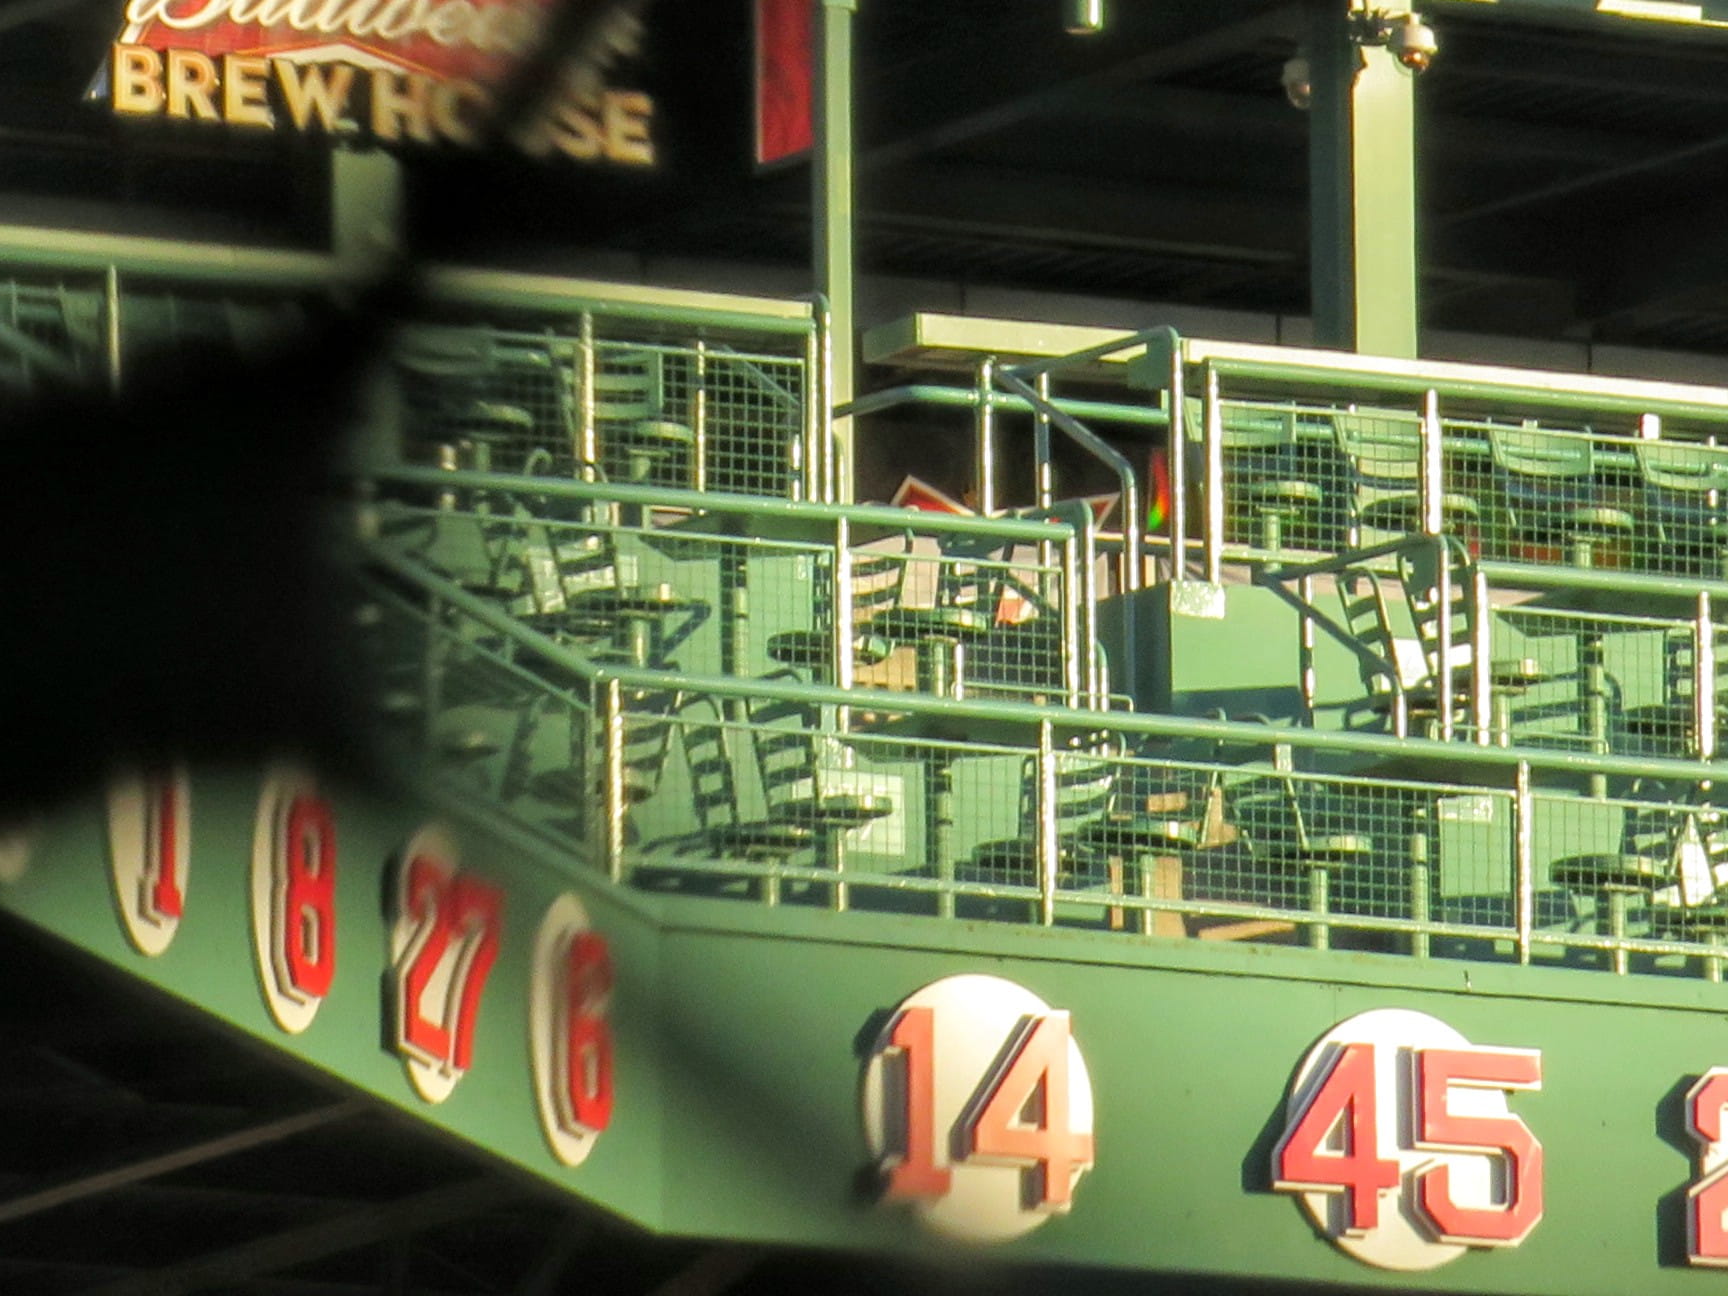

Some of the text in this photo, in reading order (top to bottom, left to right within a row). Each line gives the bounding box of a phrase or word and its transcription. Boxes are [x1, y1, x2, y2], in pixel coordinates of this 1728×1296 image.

[112, 42, 355, 135] BREW
[270, 792, 336, 1008] 8
[394, 853, 504, 1081] 27
[550, 930, 614, 1144] 6
[874, 1006, 1096, 1214] 14
[1271, 1042, 1543, 1249] 45
